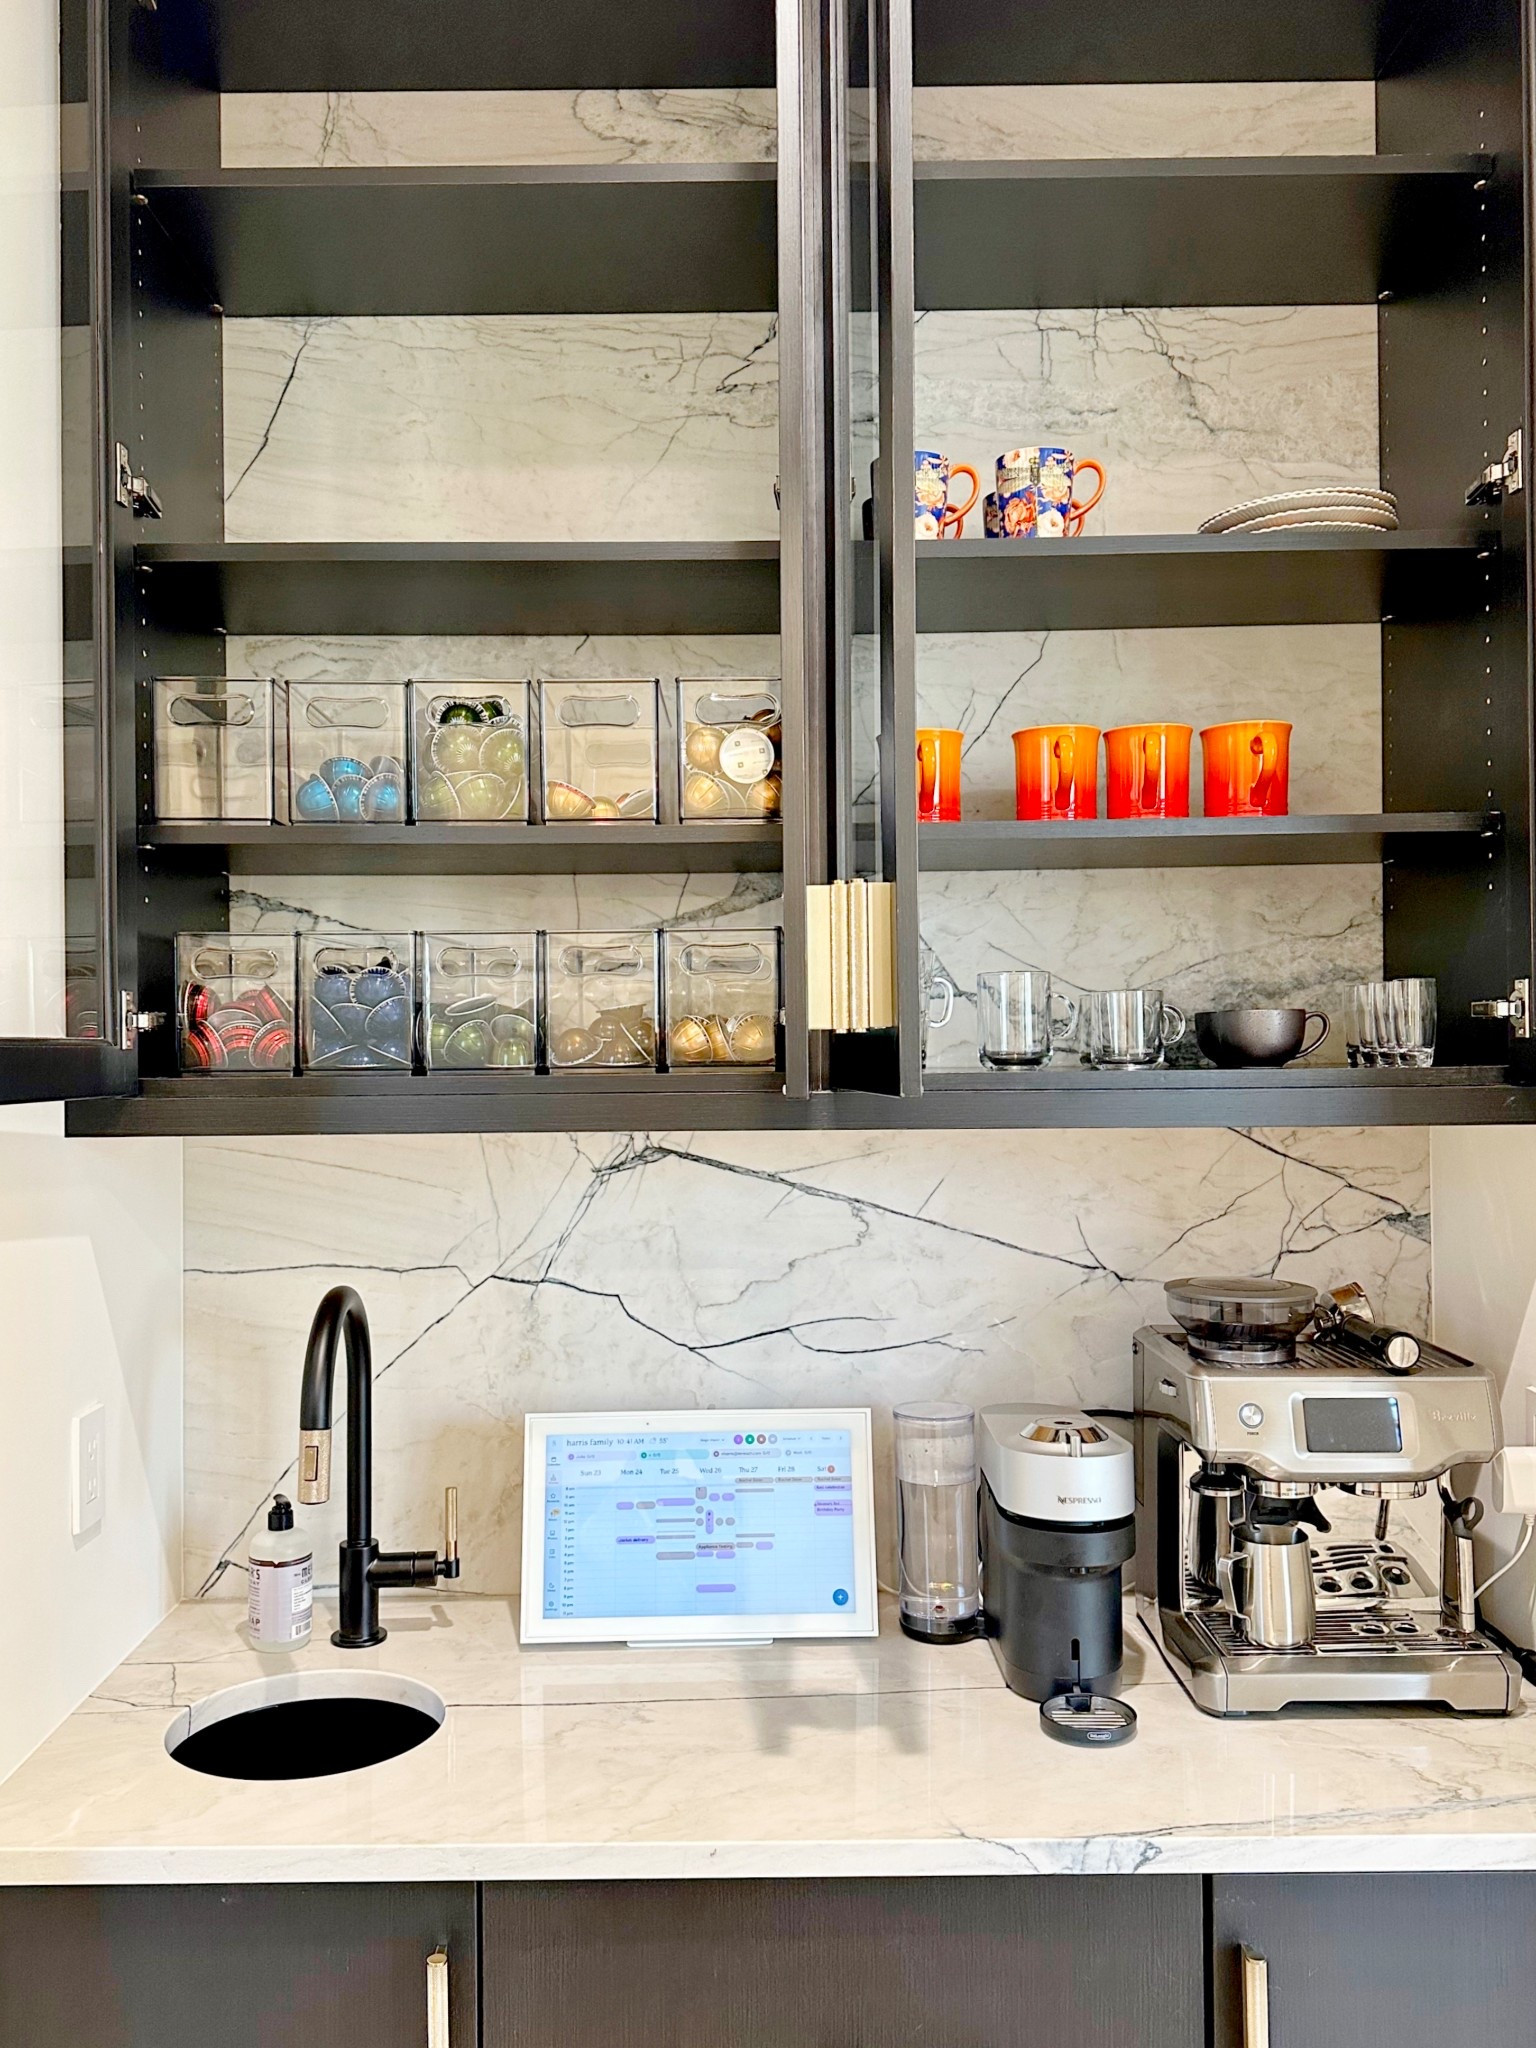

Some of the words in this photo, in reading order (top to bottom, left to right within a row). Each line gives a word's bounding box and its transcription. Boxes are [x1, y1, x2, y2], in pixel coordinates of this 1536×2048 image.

[566, 1439, 588, 1447] harris
[590, 1438, 613, 1447] family
[1057, 1495, 1102, 1505] NESPRESSO
